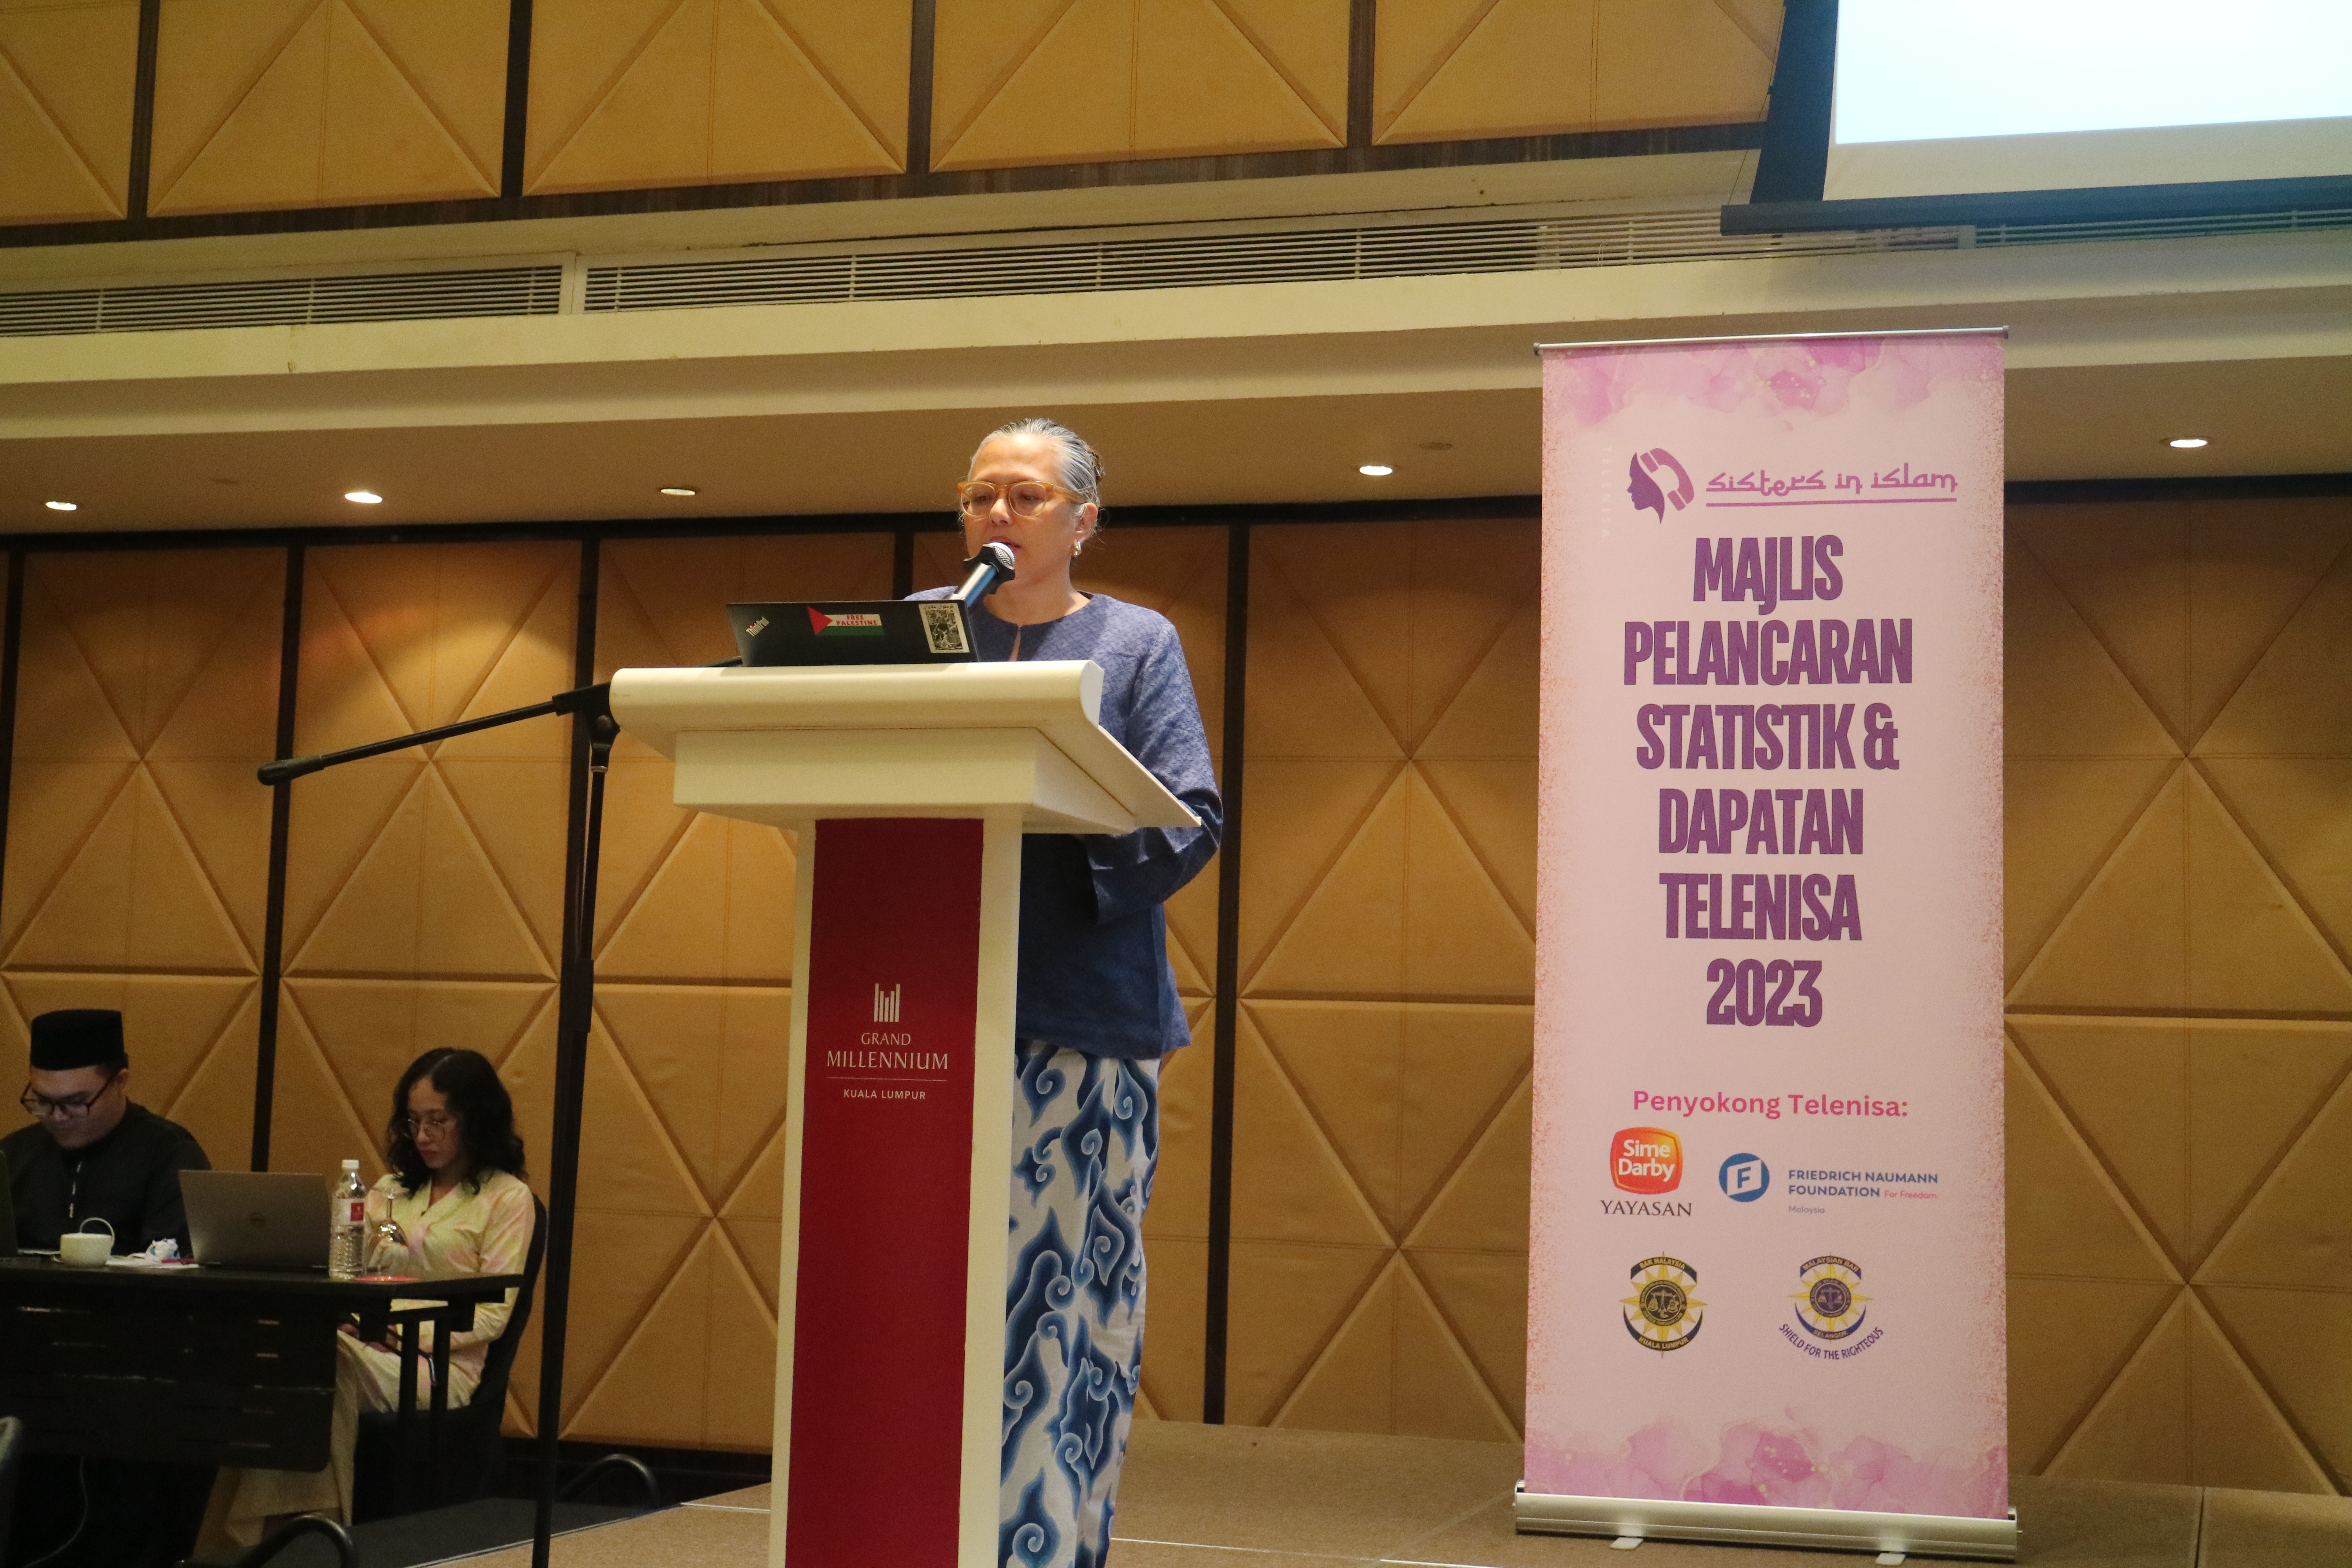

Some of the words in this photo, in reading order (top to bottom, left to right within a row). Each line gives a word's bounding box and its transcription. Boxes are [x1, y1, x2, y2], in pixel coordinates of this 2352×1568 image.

[1706, 470, 1826, 496] sisters
[1835, 473, 1863, 494] in
[1871, 463, 1958, 492] islam
[1693, 534, 1843, 615] MAJLIS
[746, 616, 769, 637] ThinkPad
[1624, 618, 1912, 686] PELANCARAN
[1637, 704, 1855, 769] STATISTIK
[1864, 702, 1900, 770] &
[1659, 788, 1863, 855] DAPATAN
[1659, 873, 1862, 941] TELENISA
[1706, 958, 1822, 1027] 2023
[861, 1033, 911, 1045] GRAND
[827, 1051, 948, 1069] MILLENNIUM
[844, 1089, 877, 1098] KUALA
[882, 1091, 926, 1100] LUMPUR
[1634, 1091, 1780, 1119] Penyokong
[1788, 1094, 1907, 1117] Telenisa:
[1623, 1139, 1670, 1158] Sime
[1618, 1158, 1675, 1182] Darby
[1789, 1170, 1861, 1181] FRIEDRICH
[1866, 1172, 1938, 1183] NAUMANN
[1789, 1185, 1880, 1197] FOUNDATION
[1884, 1190, 1898, 1198] For
[1900, 1191, 1938, 1199] Freedom.
[1601, 1200, 1692, 1216] YAYASAN
[1788, 1205, 1825, 1215] Malaysia
[1639, 1259, 1653, 1268] BAR
[1653, 1258, 1685, 1270] MALAYSIA
[1803, 1256, 1843, 1270] MALAYSIAN
[1845, 1259, 1859, 1271] BAR
[1639, 1336, 1660, 1348] KUALA
[1661, 1336, 1689, 1349] LUMPUR
[1779, 1324, 1805, 1348] SHIELD
[1804, 1343, 1821, 1357] FOR
[1824, 1350, 1840, 1360] THE
[1841, 1327, 1884, 1359] RIGHTEOUS
